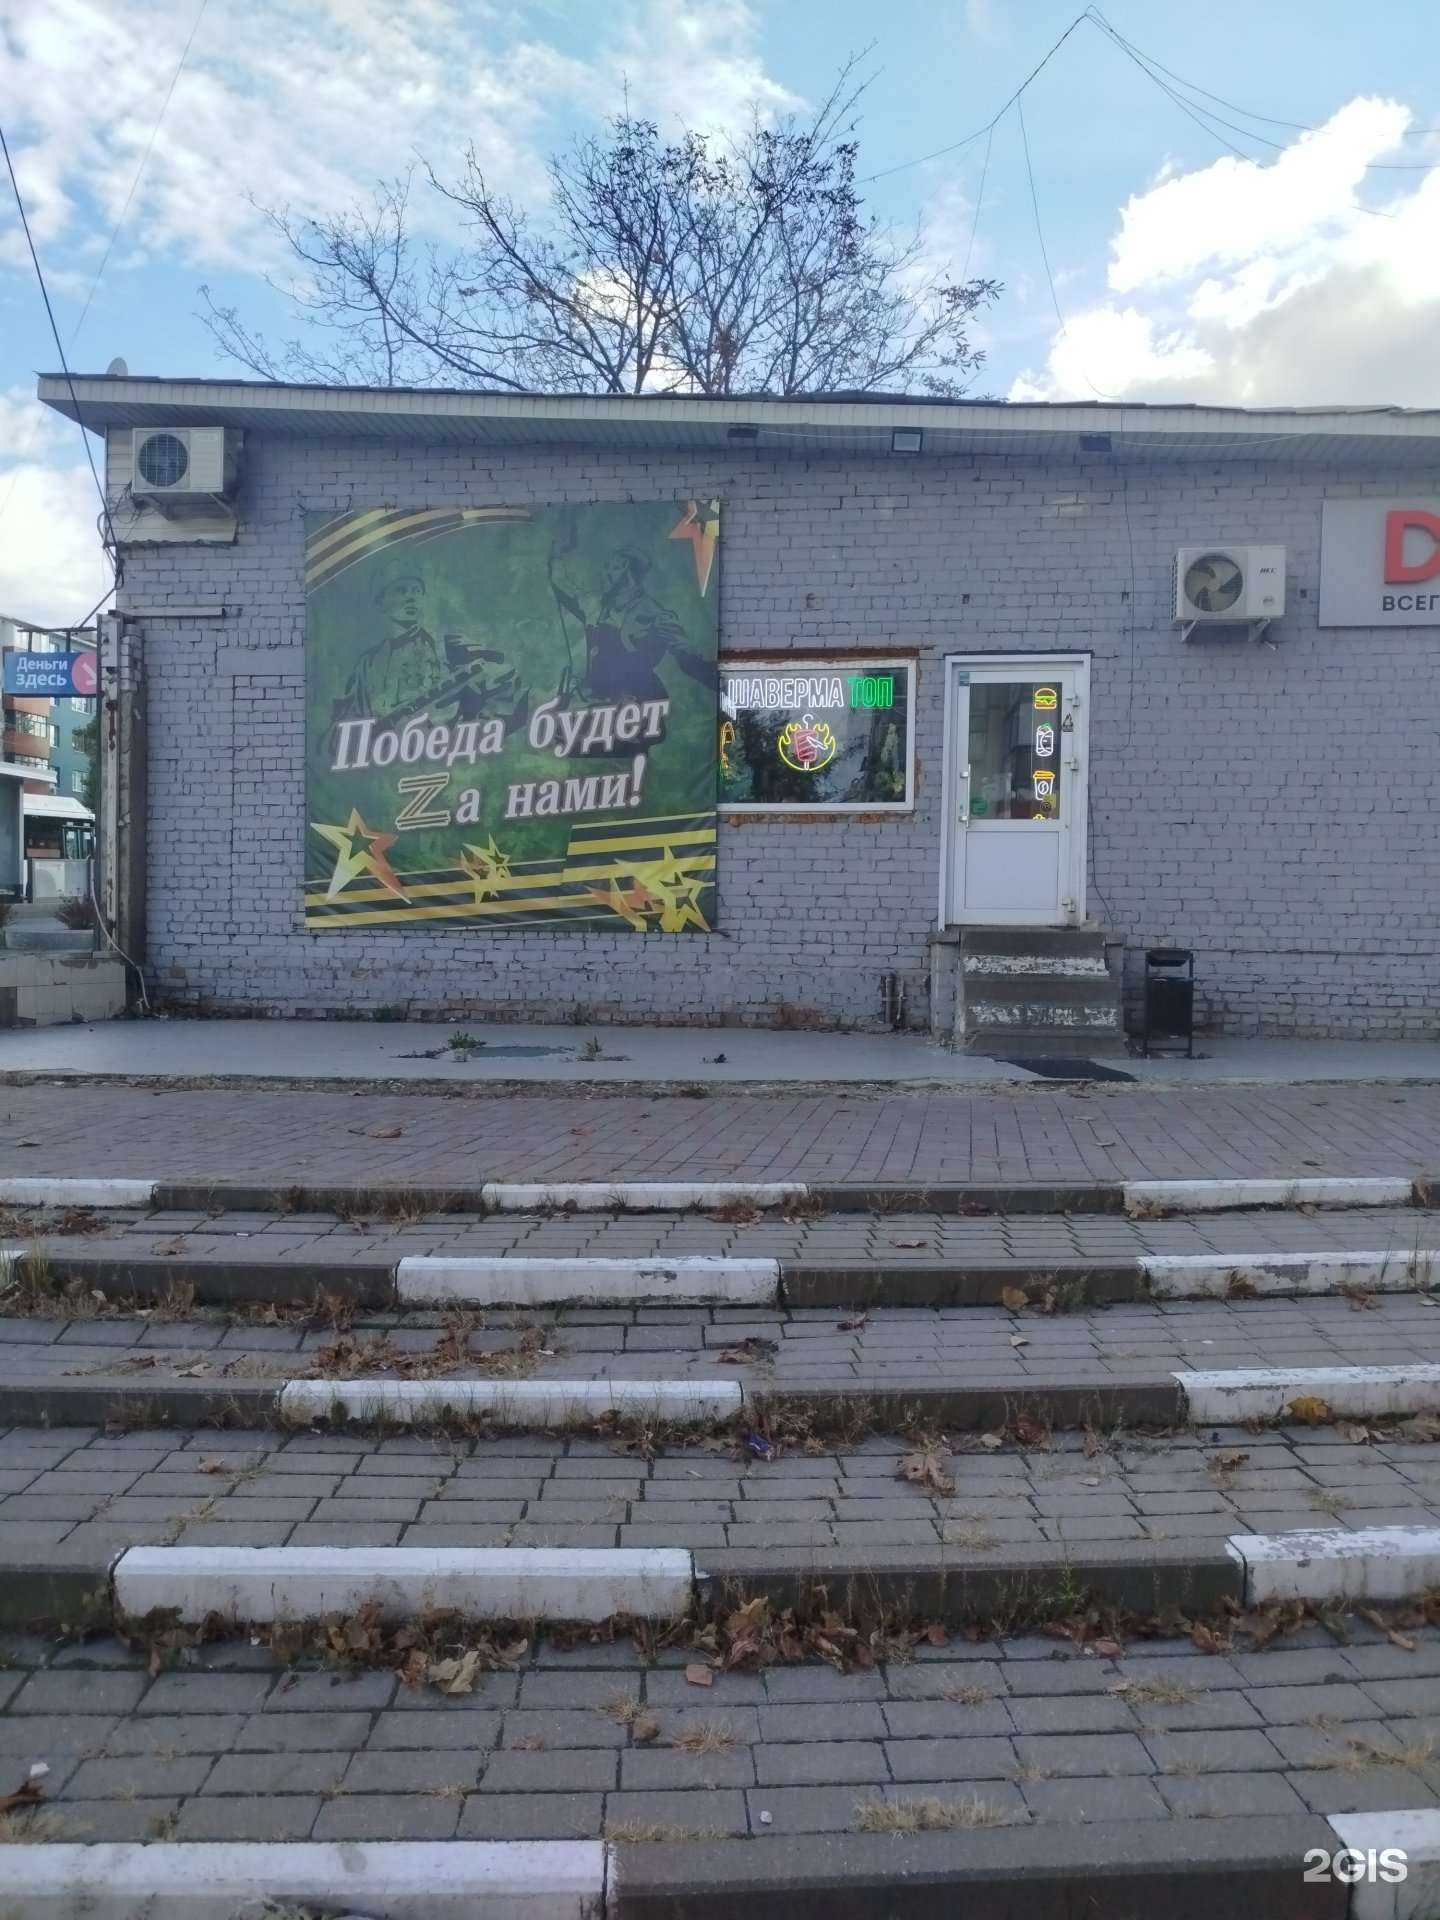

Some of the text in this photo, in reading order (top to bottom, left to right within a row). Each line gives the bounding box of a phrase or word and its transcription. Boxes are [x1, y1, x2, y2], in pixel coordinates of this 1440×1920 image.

[16, 656, 68, 672] Деньги
[16, 674, 67, 688] здесь
[727, 676, 894, 709] ШАВЕРМА ТОП
[331, 698, 669, 767] Победа будет
[505, 753, 646, 818] нами!
